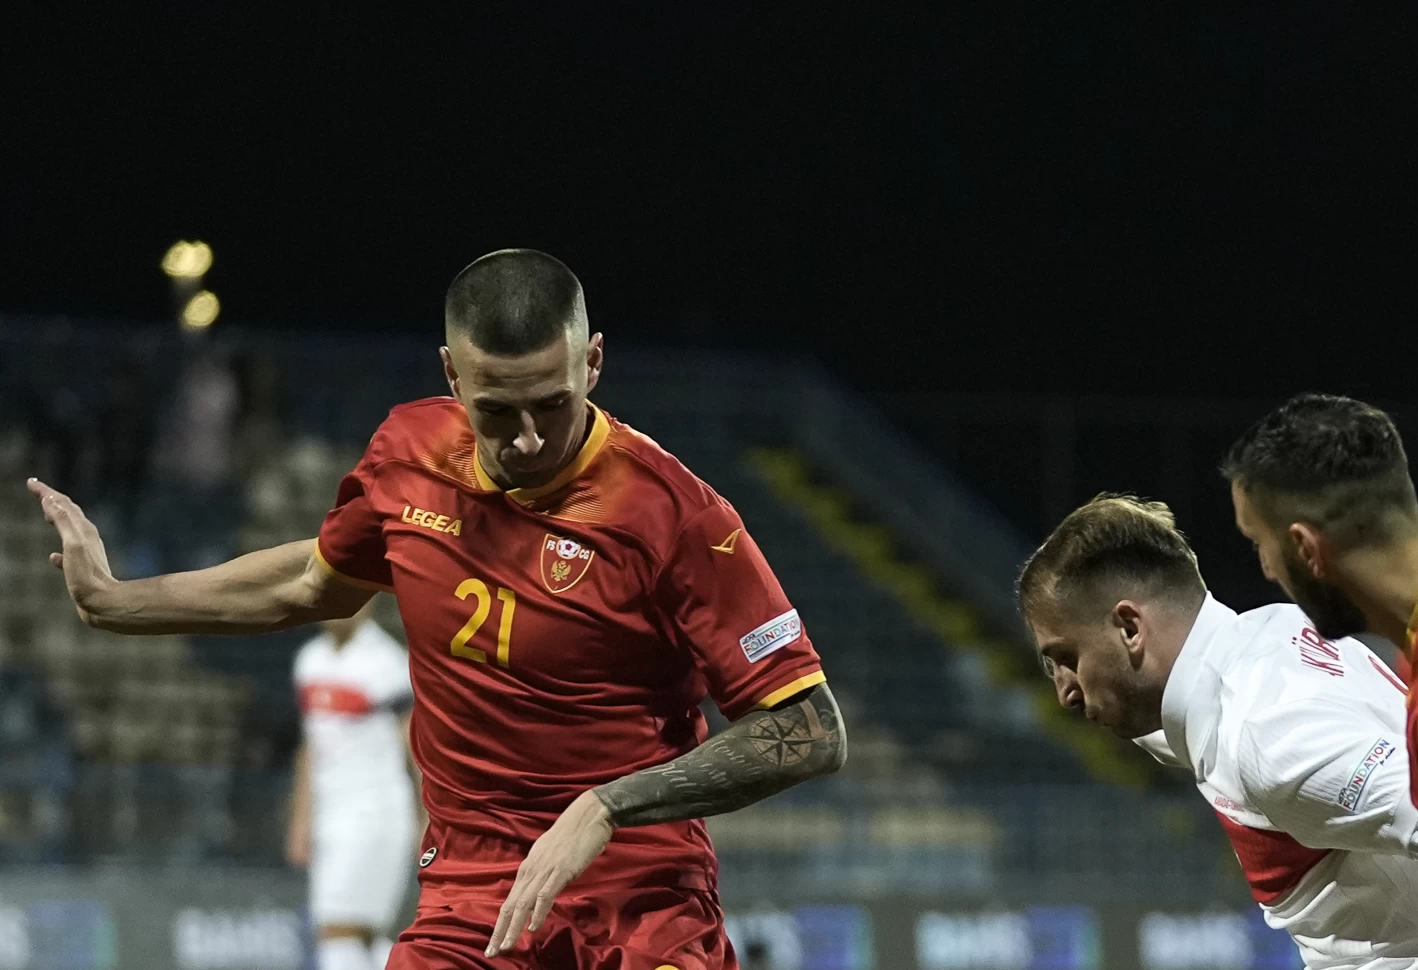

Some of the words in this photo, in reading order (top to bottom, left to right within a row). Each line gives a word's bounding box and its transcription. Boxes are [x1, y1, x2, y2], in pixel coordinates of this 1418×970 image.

[402, 505, 461, 536] LEGEA
[452, 579, 516, 668] 21
[1343, 739, 1391, 810] FOUNDATION
